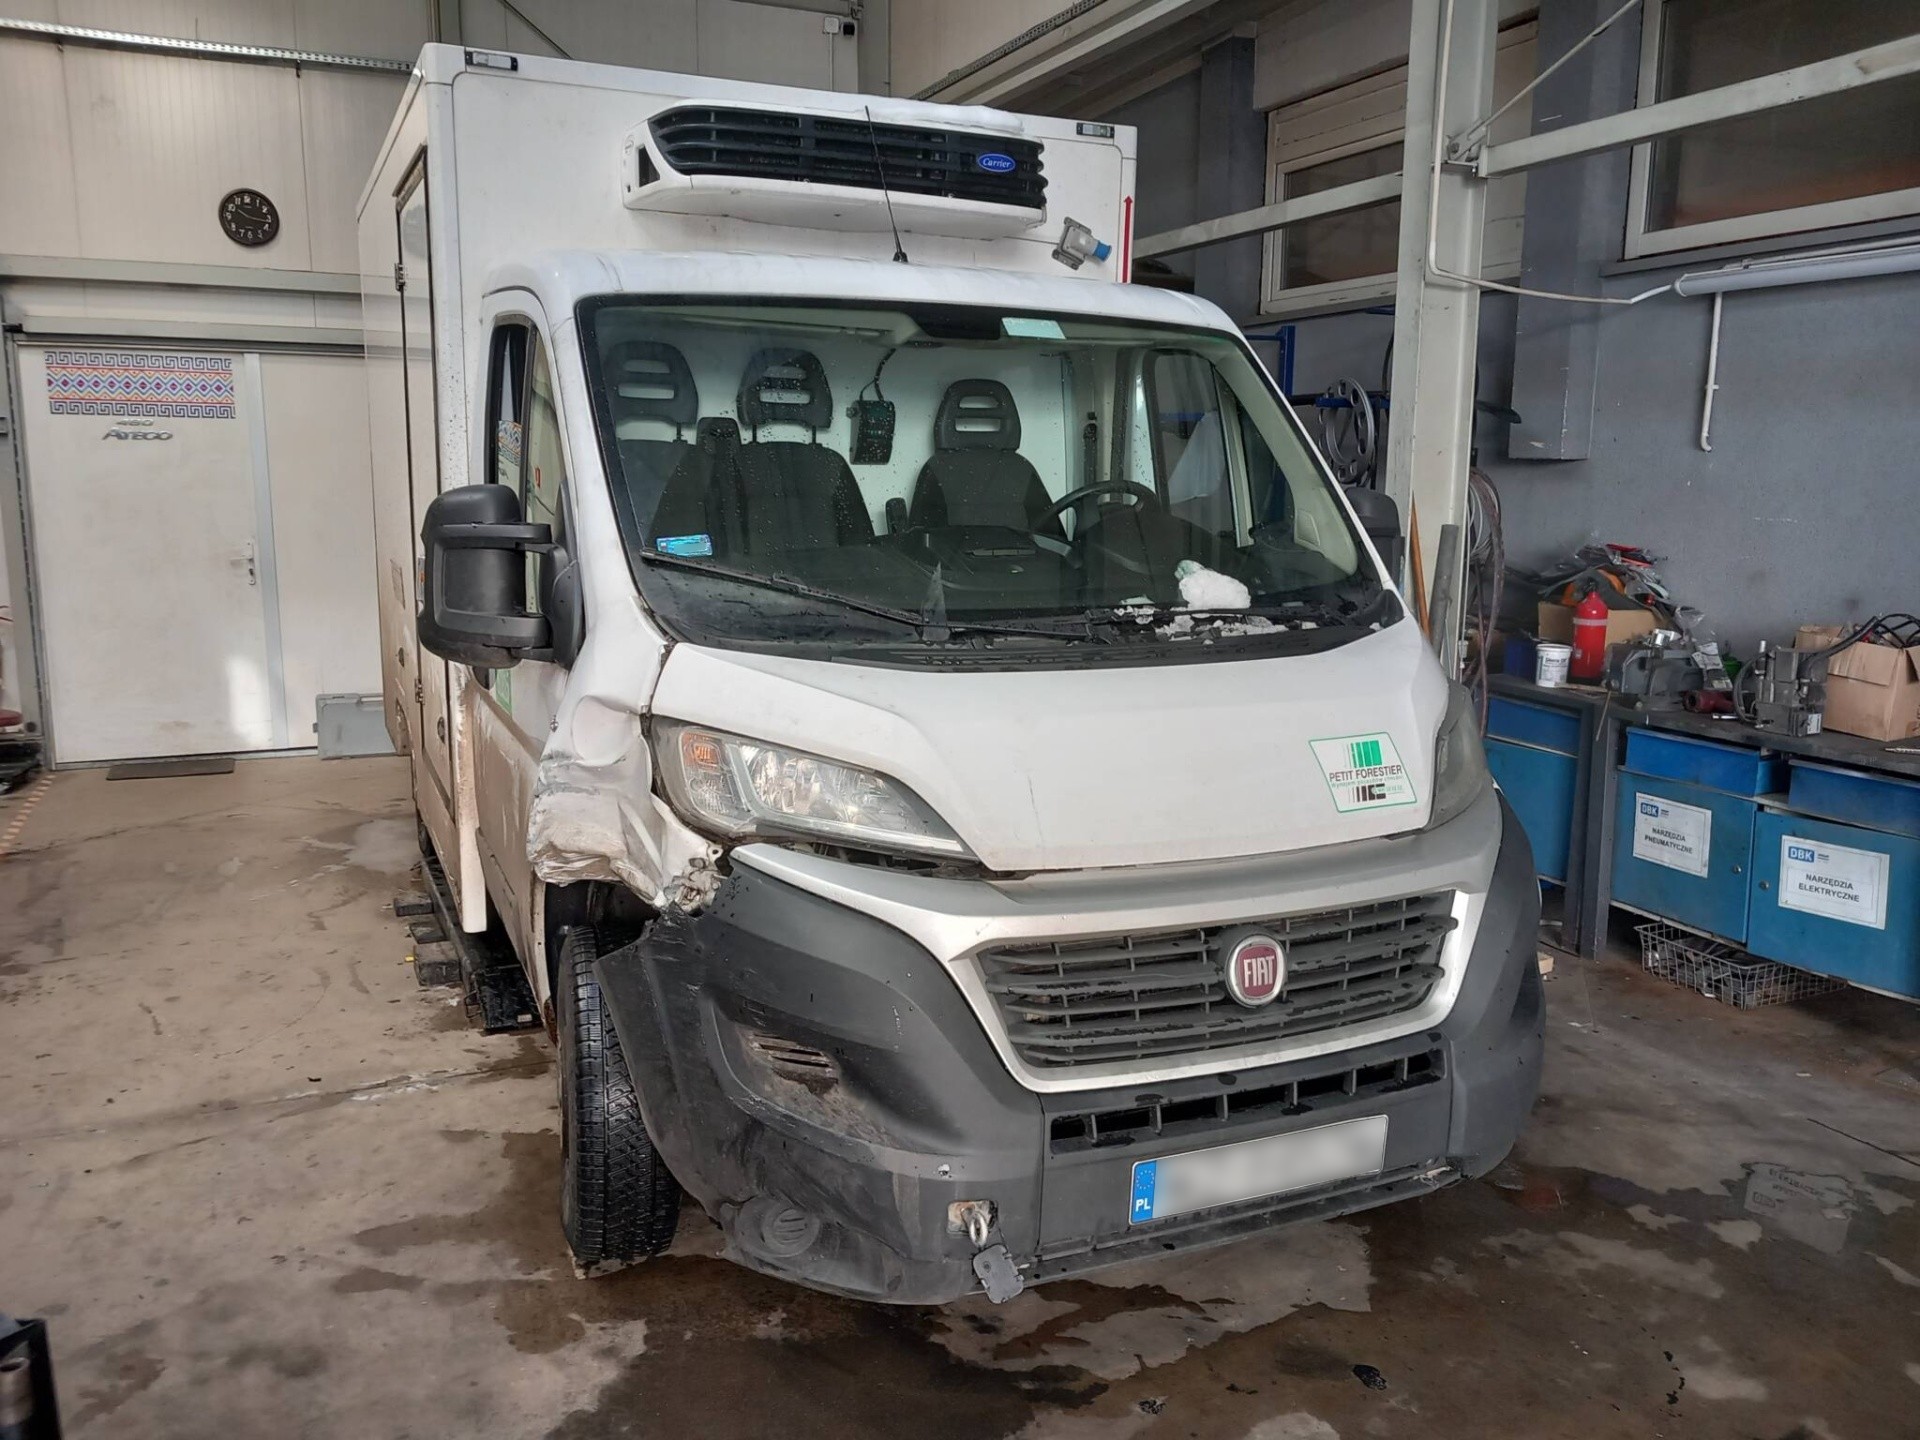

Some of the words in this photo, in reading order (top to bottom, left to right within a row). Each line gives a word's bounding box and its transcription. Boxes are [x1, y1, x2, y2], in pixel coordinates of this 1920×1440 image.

[982, 157, 1012, 169] Carrier
[1328, 769, 1354, 783] PETIT
[1355, 764, 1403, 780] FORESTIER
[1641, 804, 1658, 817] DBK
[1652, 827, 1686, 842] NARZĘDZIA
[1644, 835, 1693, 854] PNEUMATYCZNE
[1790, 847, 1813, 862] DBK
[1806, 873, 1854, 890] NARZĘDZIA
[1798, 883, 1860, 903] ELEKTRYCZNE
[1243, 955, 1275, 988] FIAT
[1135, 1197, 1151, 1212] PL
